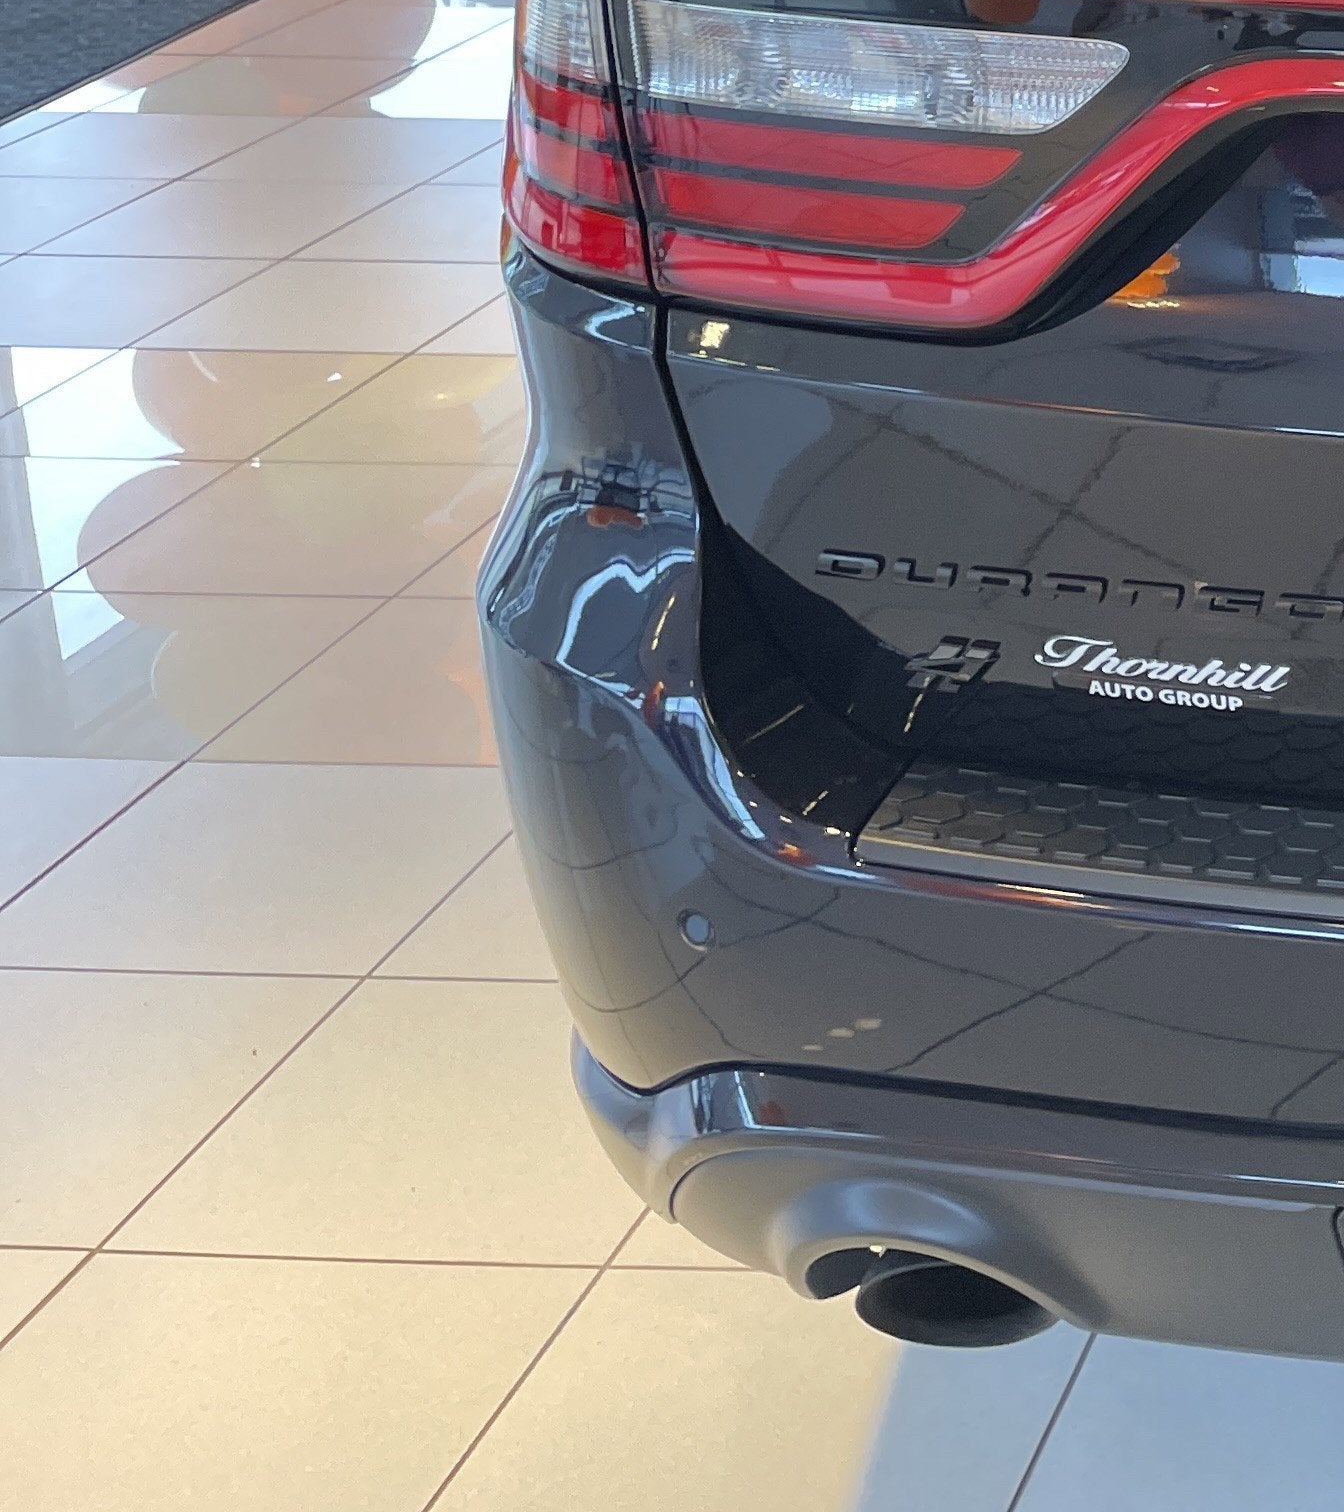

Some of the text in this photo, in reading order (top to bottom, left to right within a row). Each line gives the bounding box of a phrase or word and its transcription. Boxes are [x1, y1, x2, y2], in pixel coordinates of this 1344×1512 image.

[1034, 634, 1292, 694] Thornhill
[1088, 678, 1245, 714] AUTO GROUP
